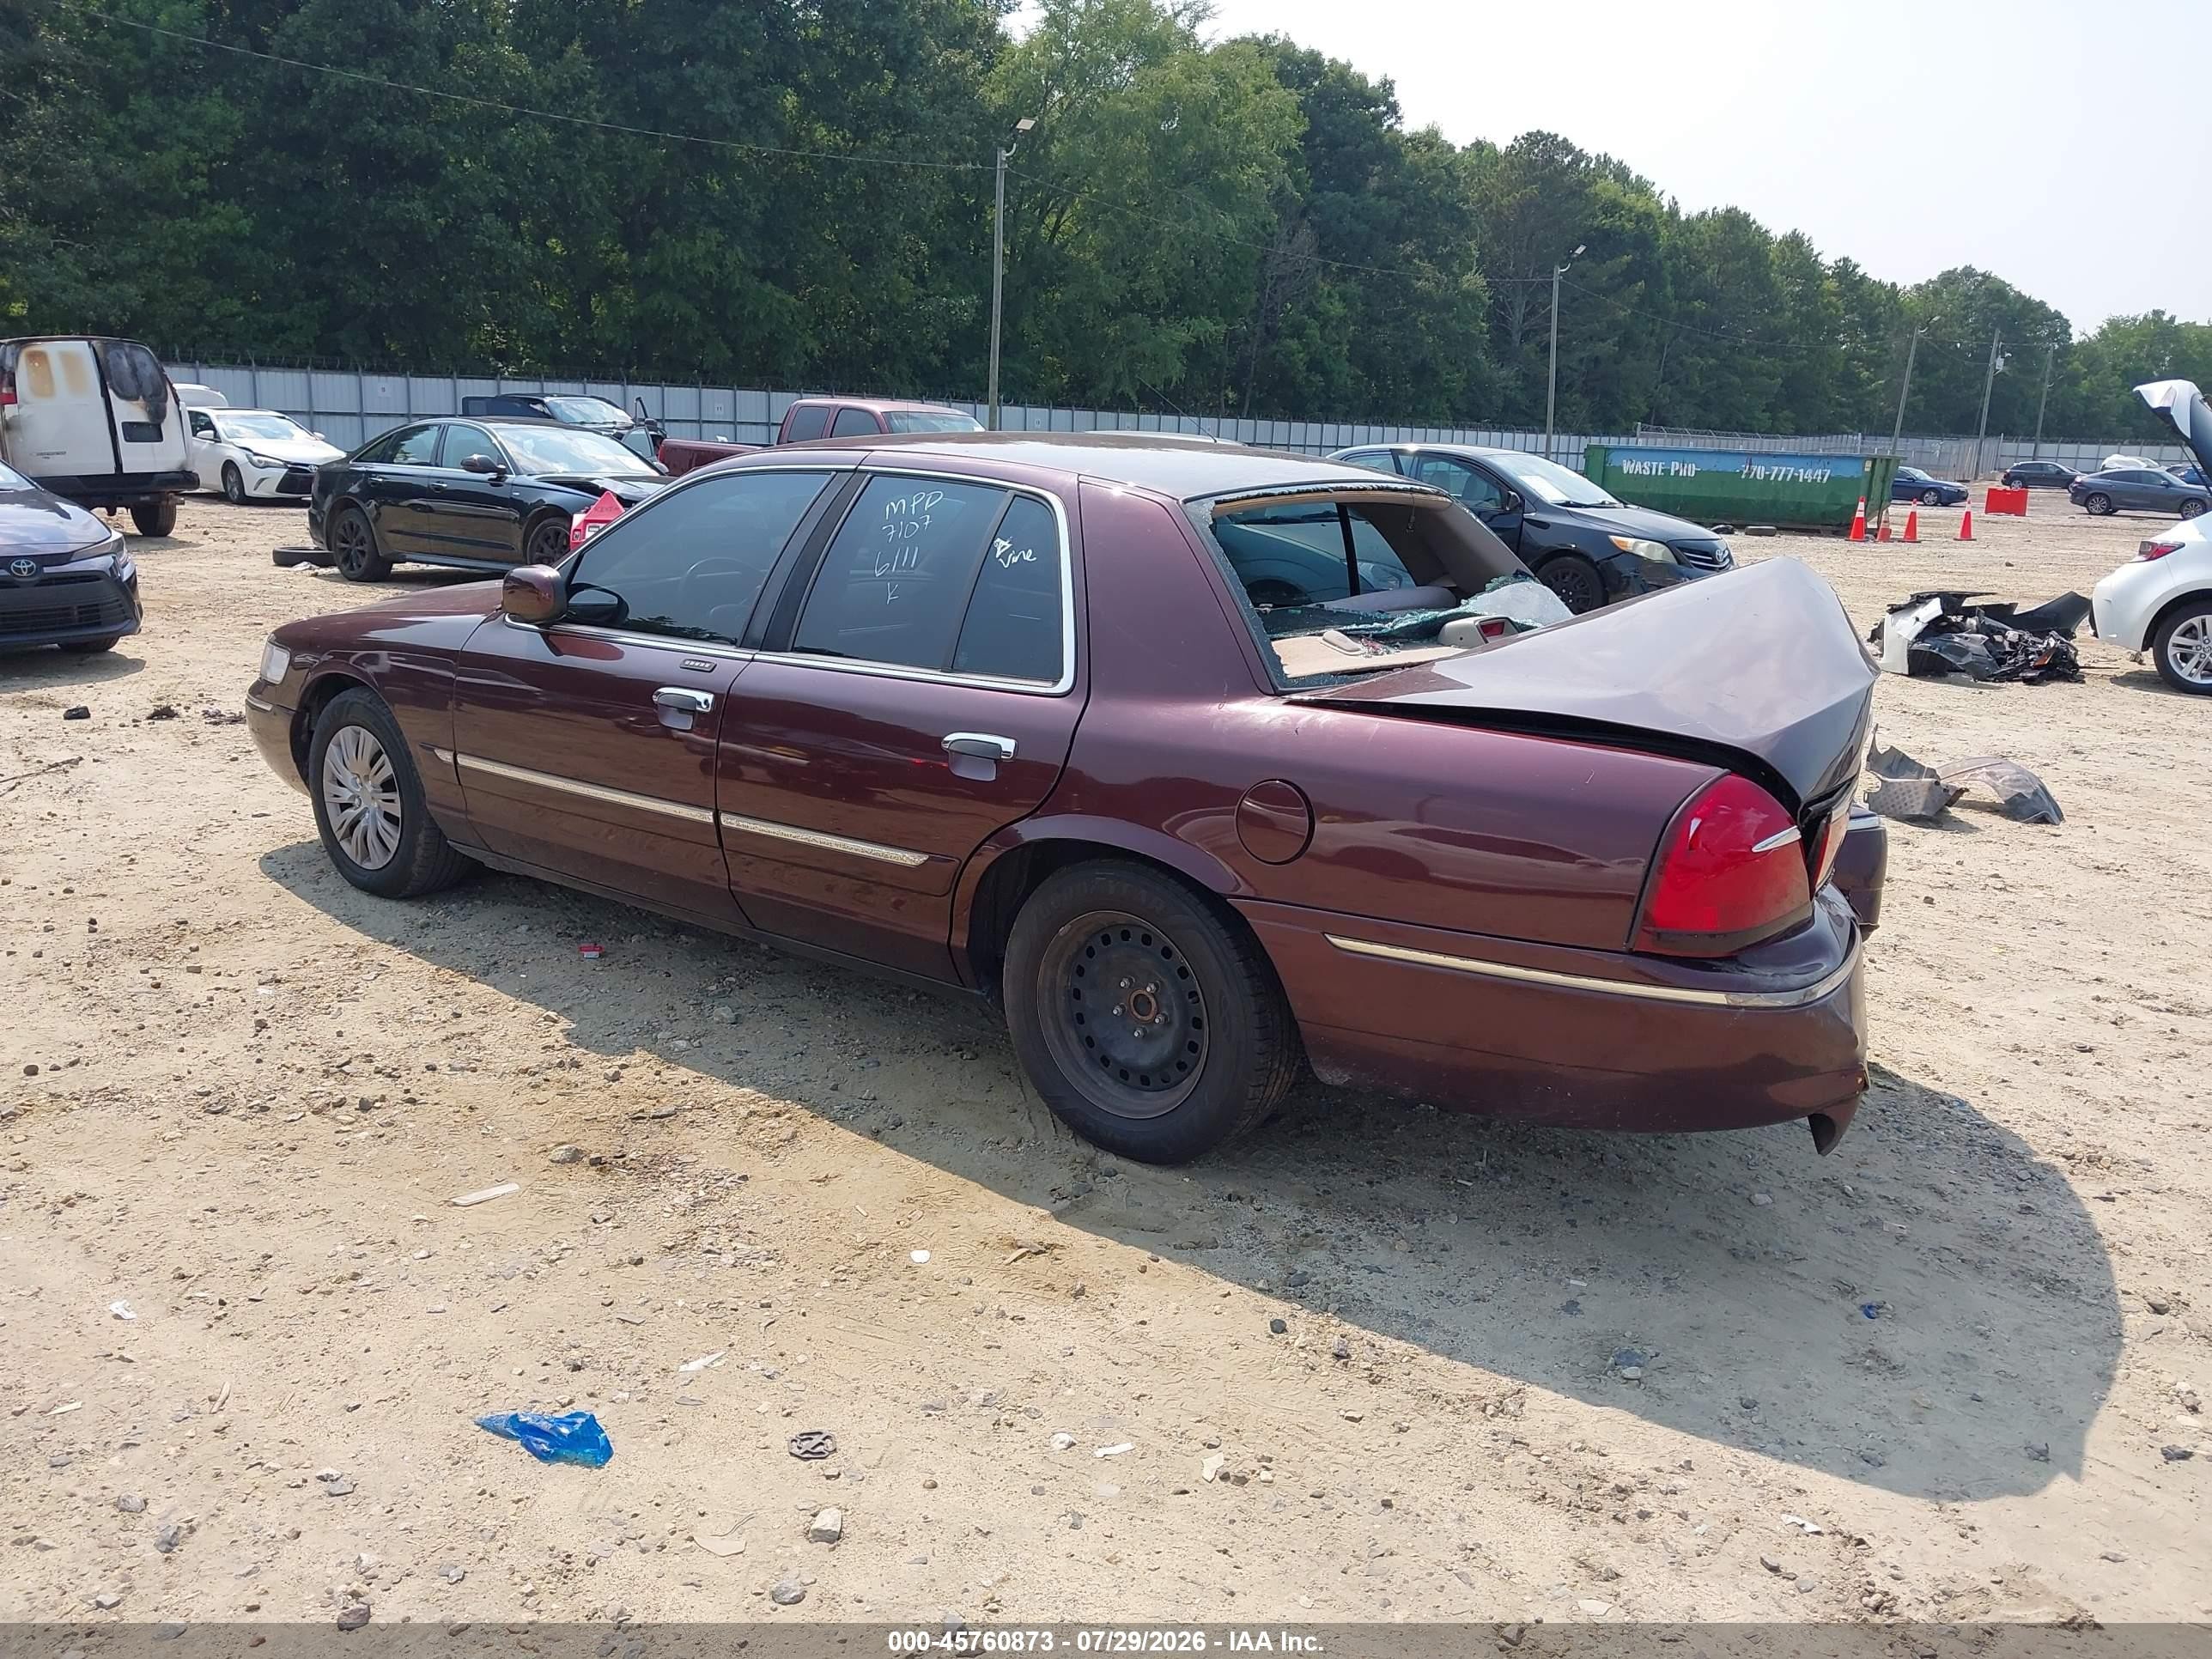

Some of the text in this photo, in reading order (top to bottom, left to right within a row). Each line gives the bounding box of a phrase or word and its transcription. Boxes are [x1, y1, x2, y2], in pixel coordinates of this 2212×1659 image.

[1622, 459, 1665, 476] WASTE
[1741, 465, 1831, 483] 770-777-1447
[885, 490, 944, 520] MPD
[882, 515, 933, 543] 7107
